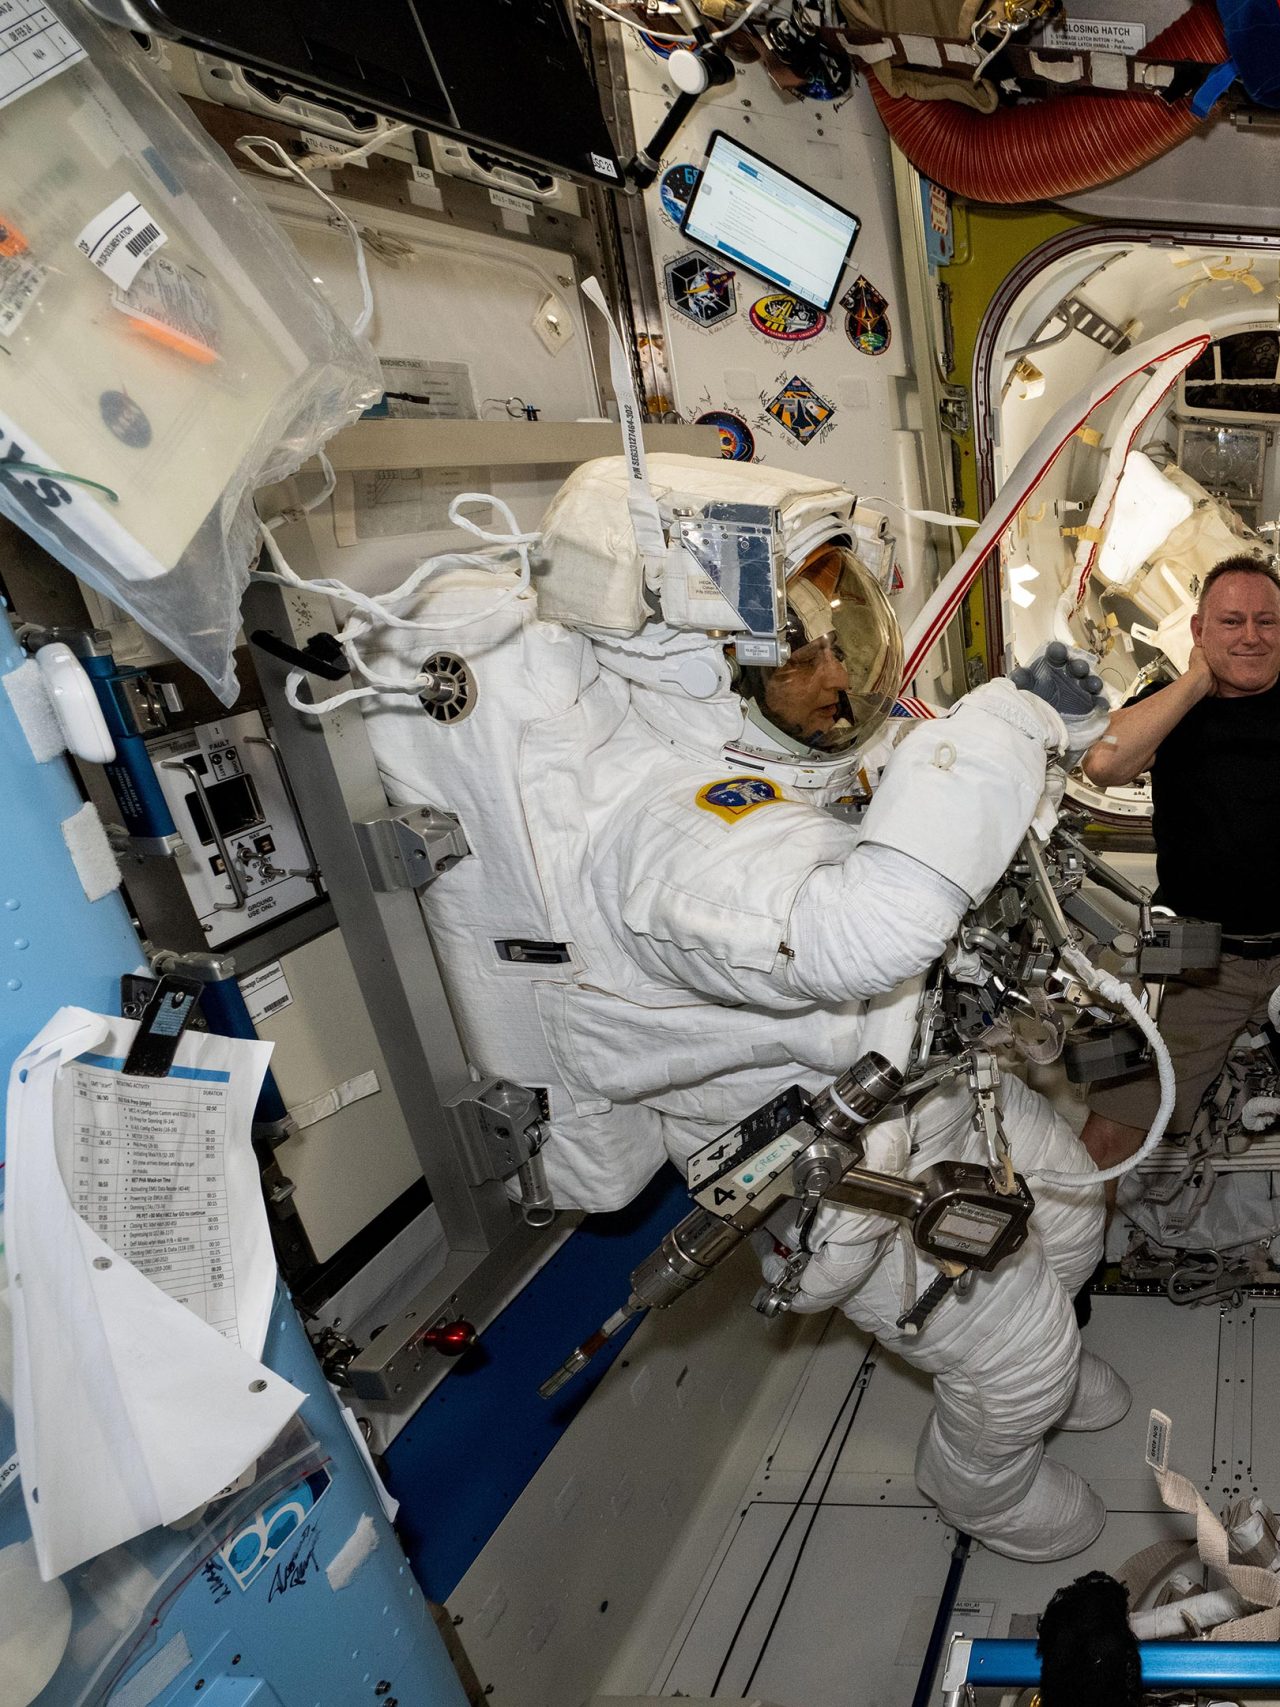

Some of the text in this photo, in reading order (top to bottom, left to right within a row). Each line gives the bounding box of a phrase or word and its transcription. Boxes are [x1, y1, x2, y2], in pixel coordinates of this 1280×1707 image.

[1063, 24, 1130, 36] CLOSING HATCH
[209, 739, 230, 750] FAULT
[248, 896, 274, 912] GROUND
[248, 900, 277, 918] USE ONLY
[203, 1090, 223, 1098] DURATION
[707, 1142, 732, 1161] 4
[754, 1138, 792, 1173] GREEN
[713, 1187, 737, 1206] 4
